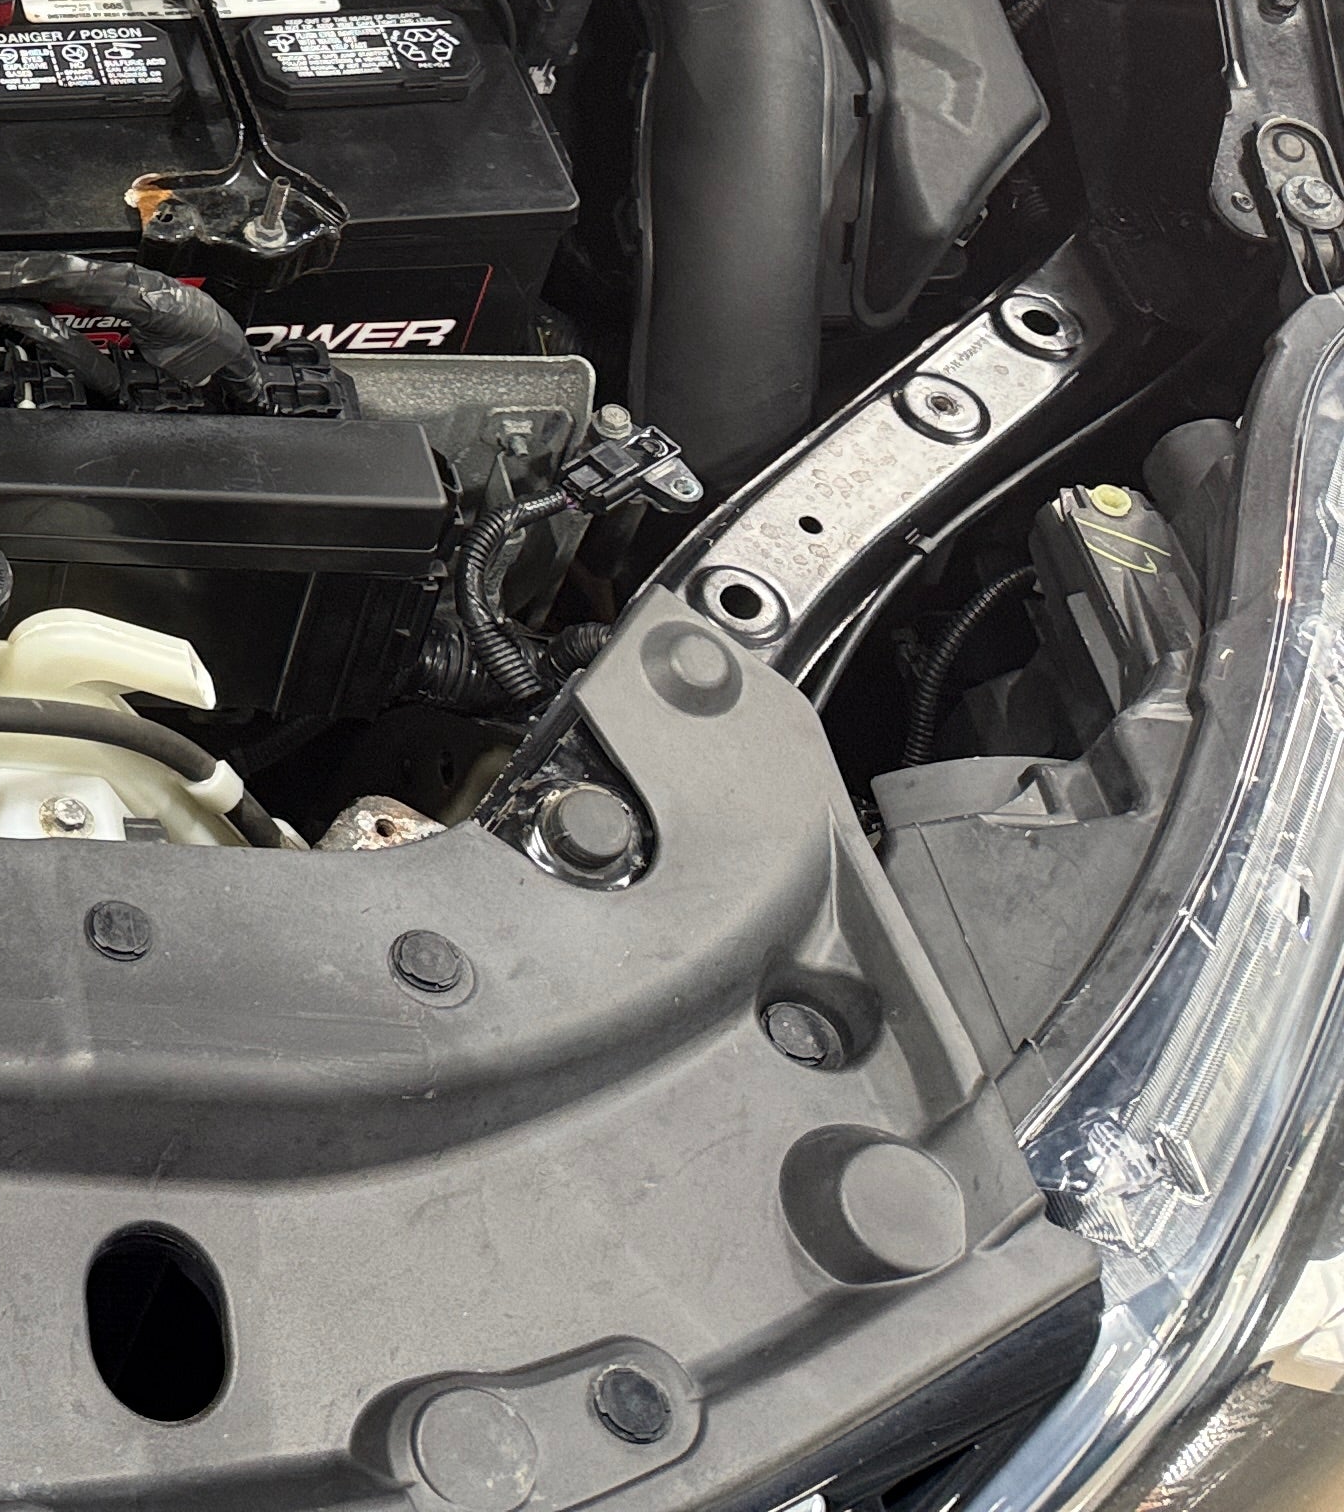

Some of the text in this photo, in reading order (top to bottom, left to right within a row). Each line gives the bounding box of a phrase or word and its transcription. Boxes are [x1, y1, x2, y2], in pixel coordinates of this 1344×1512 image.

[67, 30, 75, 41] /
[80, 28, 142, 39] POISON
[69, 61, 85, 69] NO
